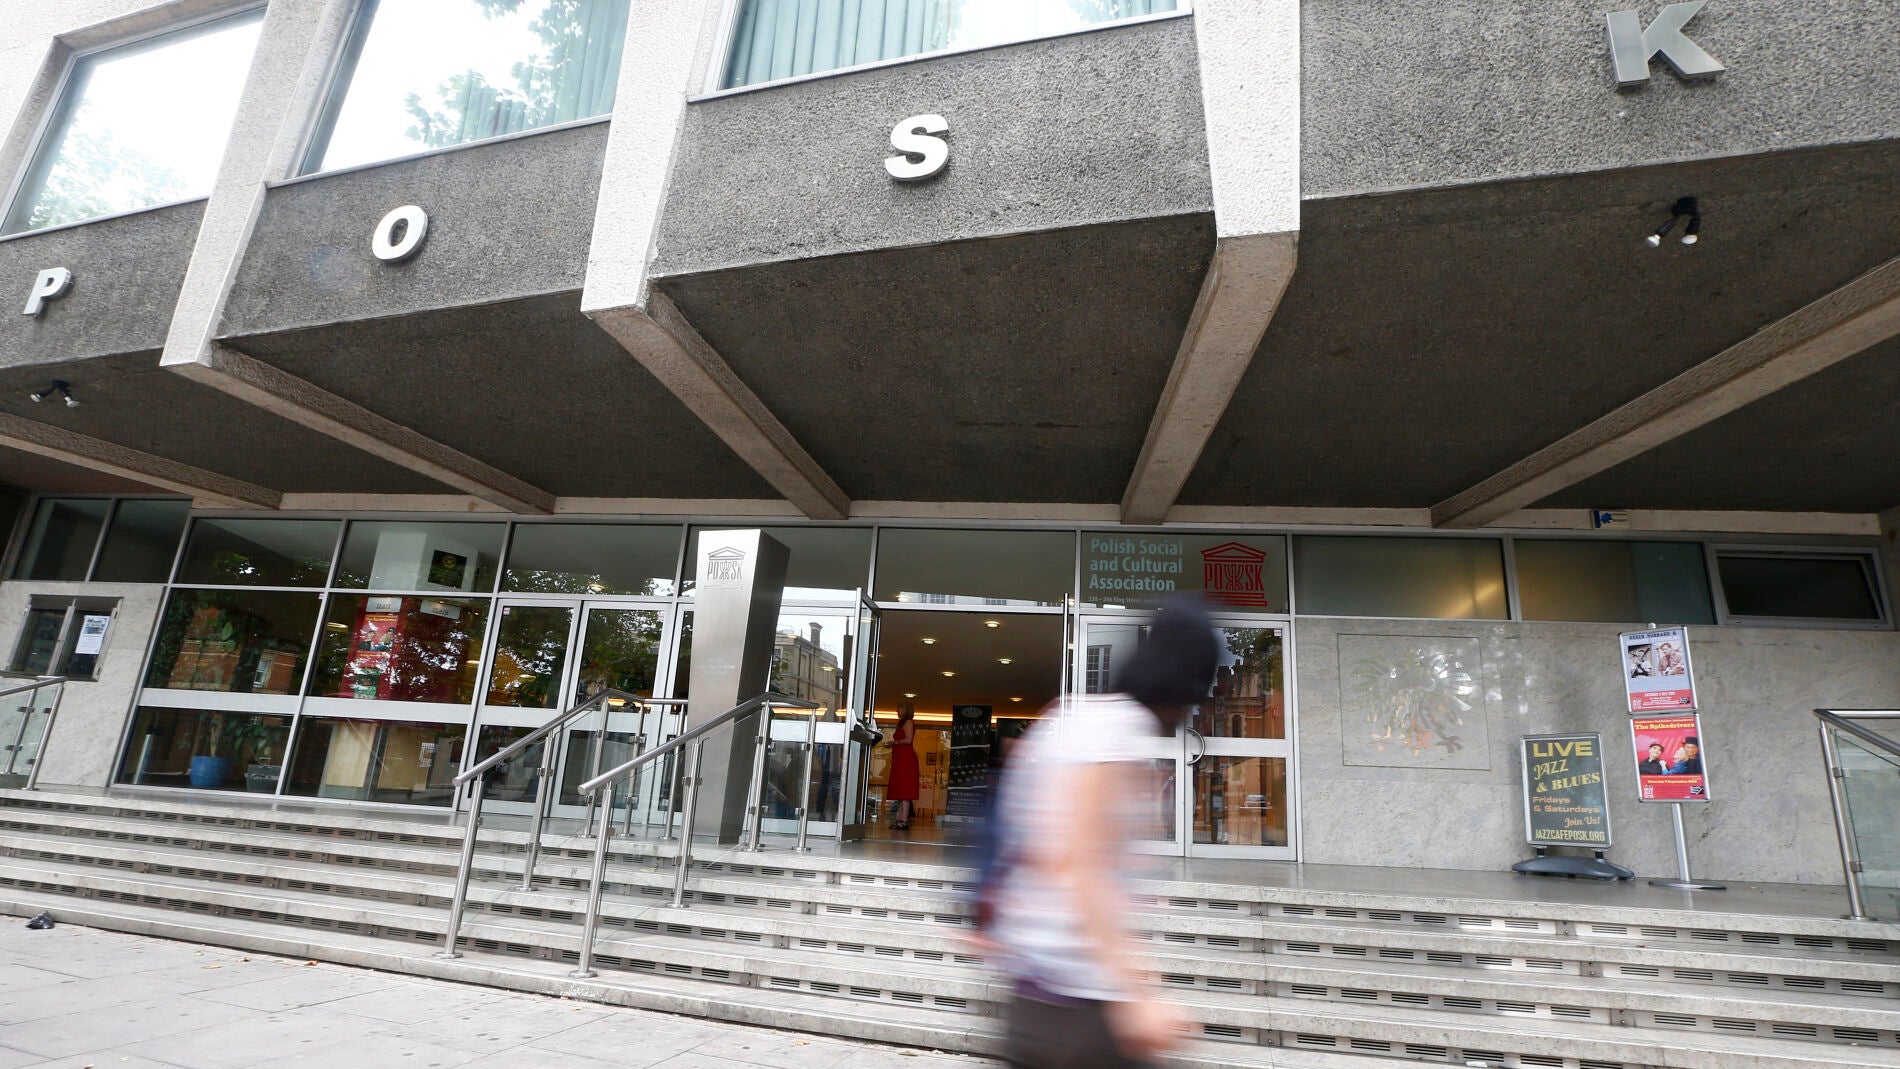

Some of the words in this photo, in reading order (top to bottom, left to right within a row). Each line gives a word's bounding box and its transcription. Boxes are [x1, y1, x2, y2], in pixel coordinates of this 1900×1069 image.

[23, 266, 71, 316] P
[372, 204, 428, 262] O
[884, 109, 950, 180] S
[1605, 0, 1725, 84] K
[1090, 538, 1136, 555] Polish
[1139, 539, 1184, 556] Social
[1090, 556, 1119, 572] and
[1122, 556, 1183, 574] Cultural
[1089, 573, 1175, 591] Association
[1533, 741, 1593, 757] LIVE
[1533, 759, 1569, 780] JAZZ
[1536, 782, 1548, 793] &
[1551, 772, 1601, 790] BLUES
[1532, 796, 1570, 804] Fridays
[1544, 805, 1600, 814] Saturdays
[1564, 818, 1583, 828] Join
[1584, 817, 1600, 825] Us!
[1535, 829, 1605, 842] JAZZCAFEPOSK.ORG
